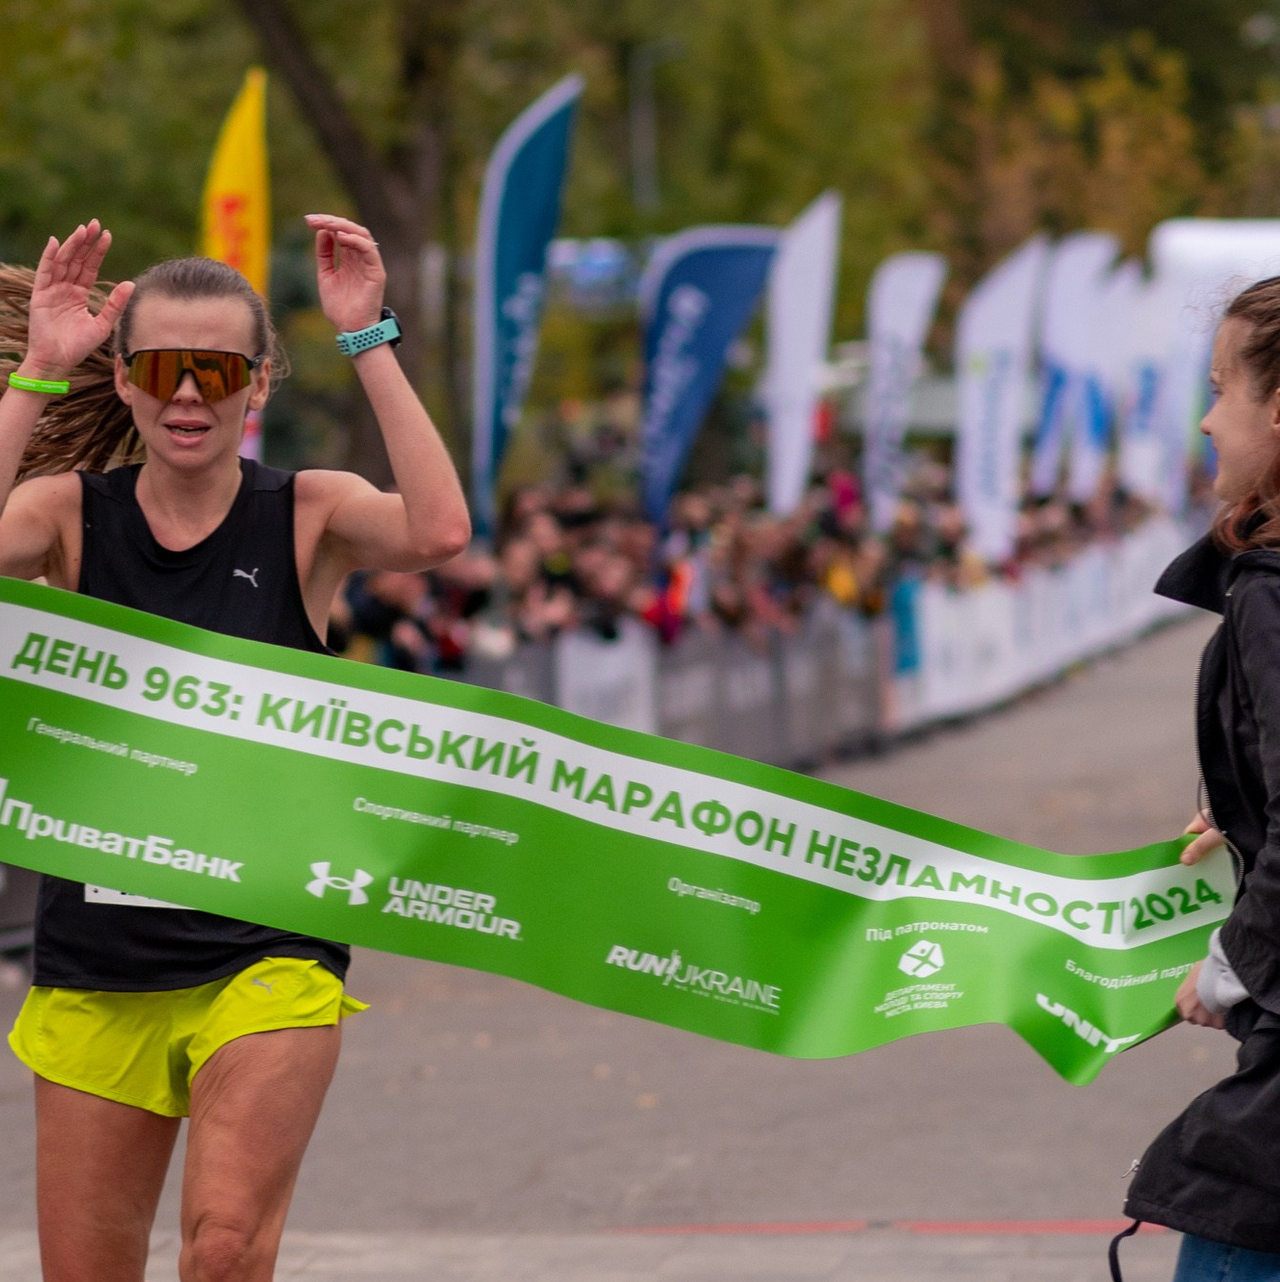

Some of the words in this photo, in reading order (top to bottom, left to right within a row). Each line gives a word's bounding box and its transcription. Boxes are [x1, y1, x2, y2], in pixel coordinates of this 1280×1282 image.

[27, 717, 129, 758] Генеральний
[130, 747, 199, 776] партнер
[11, 631, 129, 691] ДЕНЬ
[140, 666, 245, 721] 963:
[256, 692, 541, 785] КИЇВСЬКИЙ
[550, 758, 797, 857] МАРАФОН
[1129, 878, 1224, 931] 2024
[0, 797, 245, 883] ПриватБанк
[353, 796, 452, 830] Спортивний
[452, 820, 520, 846] партнер
[388, 876, 497, 914] UNDER
[666, 876, 762, 916] Організатор
[381, 896, 523, 941] ARMOUR
[865, 927, 893, 942] Під
[894, 921, 989, 936] патронатом
[1064, 959, 1159, 990] Благодійний
